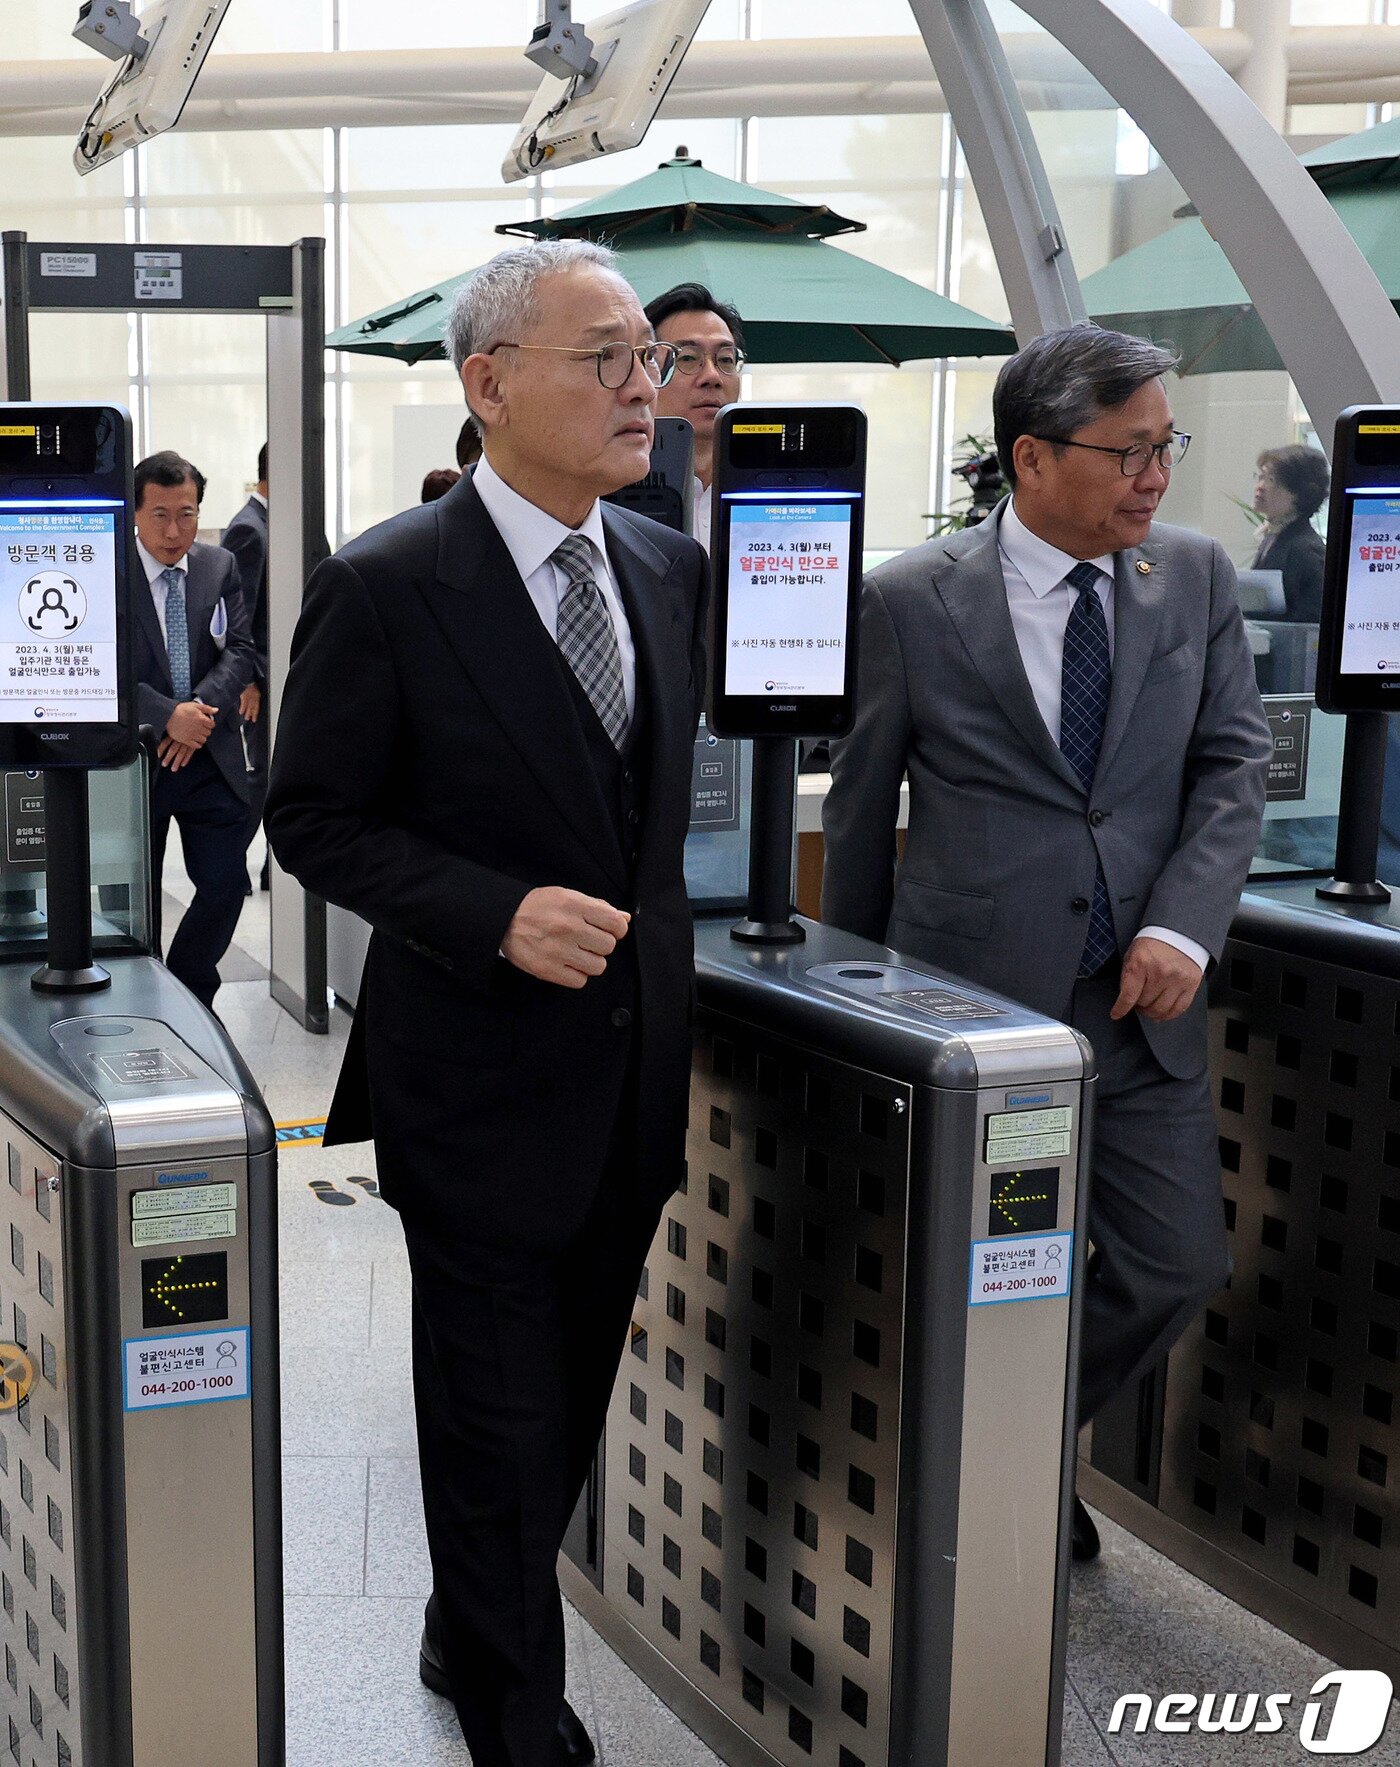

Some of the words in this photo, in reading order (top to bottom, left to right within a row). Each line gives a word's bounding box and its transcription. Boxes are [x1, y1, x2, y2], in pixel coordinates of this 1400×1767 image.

[1367, 534, 1392, 542] 2023.
[8, 544, 56, 562] 방문객
[63, 544, 95, 562] 겸용
[748, 543, 775, 552] 2023.
[777, 543, 787, 552] 4.
[790, 542, 811, 552] 3(월)
[814, 542, 831, 552] 부터
[1359, 546, 1400, 561] 얼굴인
[740, 556, 793, 571] 얼굴인식
[798, 556, 839, 571] 만으로
[1368, 563, 1393, 572] 출입이
[751, 575, 777, 585] 출입이
[780, 575, 826, 584] 가능합니다.
[1357, 622, 1373, 630] 사진
[1374, 622, 1389, 630] 자동
[15, 645, 40, 654] 2023.
[43, 645, 52, 654] 4.
[54, 645, 75, 654] 3(월)
[76, 645, 93, 654] 부터
[741, 639, 758, 648] 사진
[760, 639, 776, 648] 자동
[779, 639, 803, 648] 현행화
[806, 639, 814, 648] 중
[816, 639, 843, 648] 입니다.
[19, 656, 52, 665] 입주기관
[54, 656, 71, 665] 직원
[73, 656, 89, 665] 등은
[9, 667, 66, 676] 얼굴인식만으로
[68, 667, 101, 676] 출입가능
[28, 837, 45, 845] 열립니
[158, 1171, 209, 1185] GUNNEBO
[983, 1248, 1036, 1262] 얼굴인식시스템
[983, 1260, 1036, 1274] 불편신고센터
[982, 1275, 1057, 1293] 044-200-1000
[139, 1346, 204, 1363] 얼굴인식시스템
[139, 1358, 205, 1375] 불편신고센터
[141, 1375, 233, 1396] 044-200-1000
